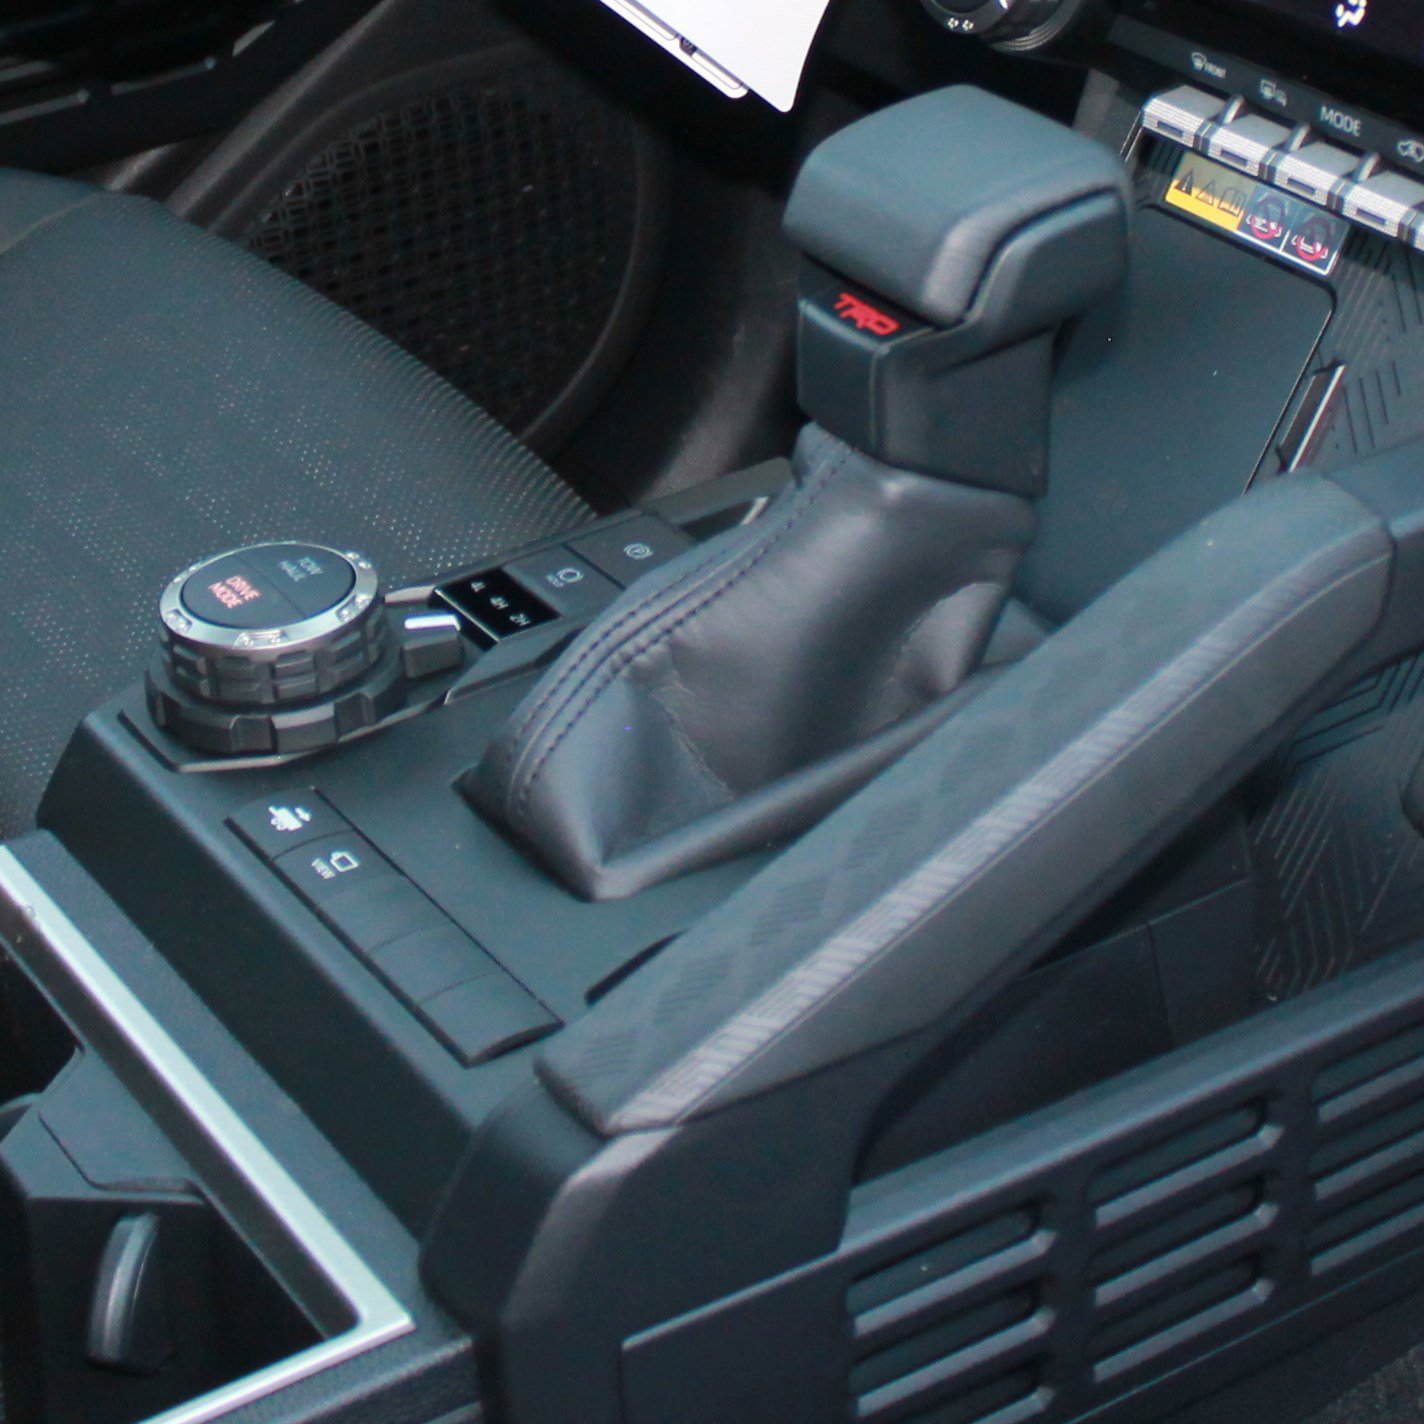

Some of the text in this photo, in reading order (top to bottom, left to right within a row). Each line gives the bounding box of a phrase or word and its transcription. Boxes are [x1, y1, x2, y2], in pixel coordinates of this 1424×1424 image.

[1320, 106, 1363, 138] MODE
[835, 292, 900, 335] TRD
[208, 581, 243, 609] MODE
[226, 575, 261, 601] DRIVE
